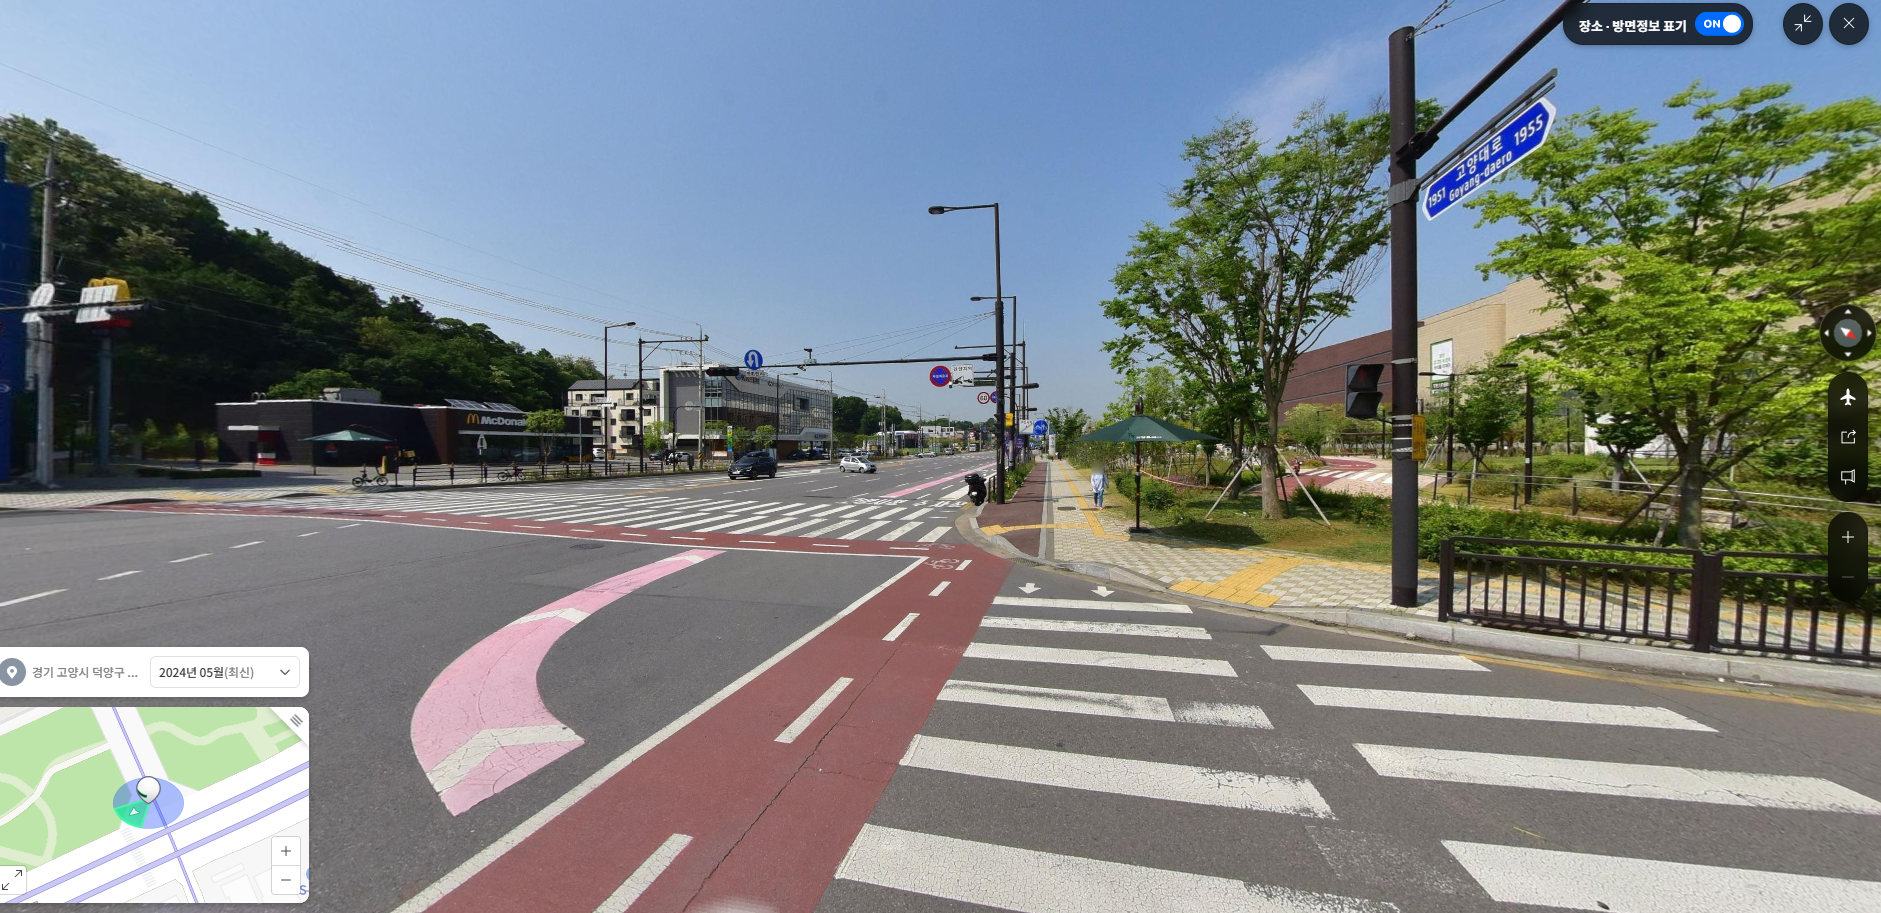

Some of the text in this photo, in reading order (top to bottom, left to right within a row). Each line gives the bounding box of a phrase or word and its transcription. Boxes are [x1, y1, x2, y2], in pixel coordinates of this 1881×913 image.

[1514, 114, 1543, 146] 1955
[1449, 151, 1512, 201] Goyang-daero
[1456, 135, 1503, 181] 고양대로
[1428, 186, 1446, 208] 1951
